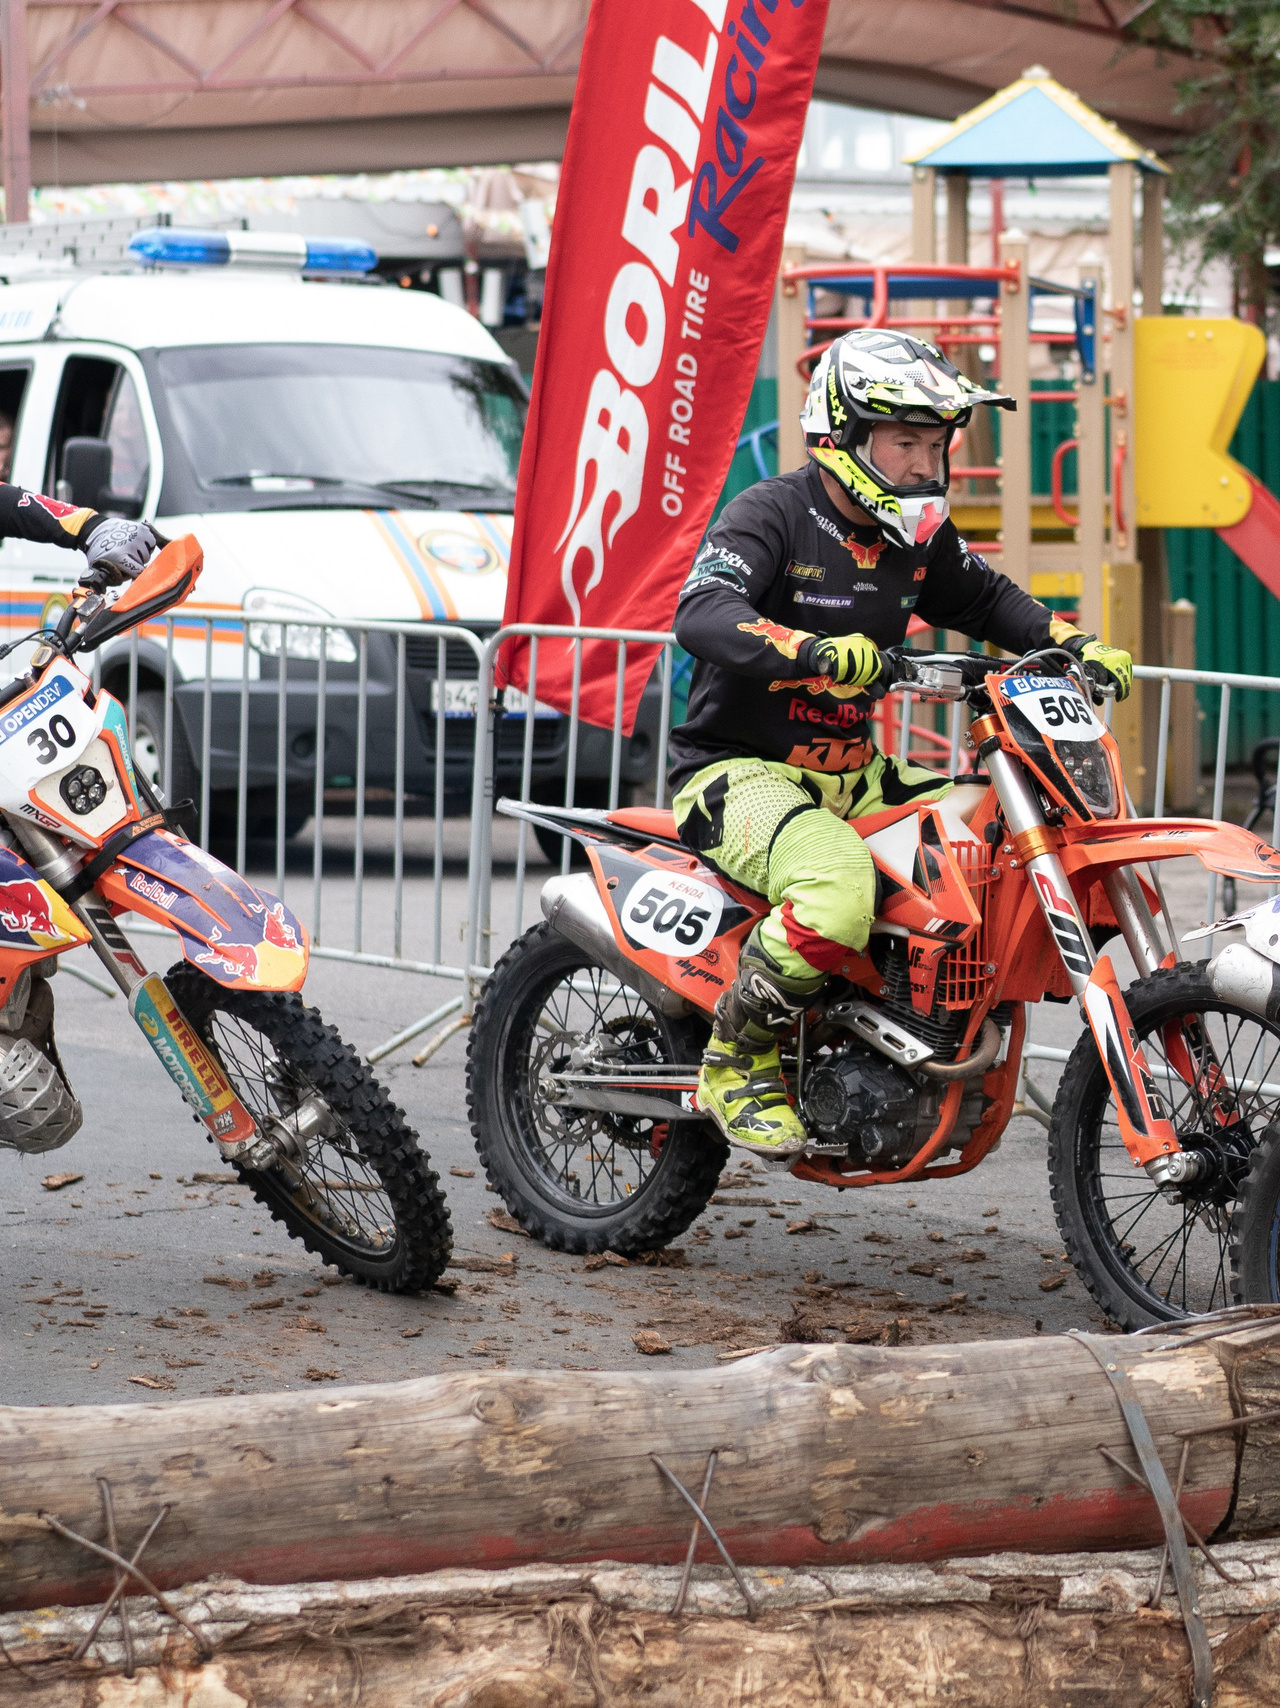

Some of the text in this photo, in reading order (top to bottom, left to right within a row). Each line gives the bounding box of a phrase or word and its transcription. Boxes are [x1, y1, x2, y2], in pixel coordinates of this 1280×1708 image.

[688, 0, 806, 254] Racin
[661, 268, 710, 517] OFF ROAD TIRE
[805, 596, 852, 607] MICHELIN
[4, 683, 62, 732] OPENDEV
[1038, 695, 1093, 727] 505
[27, 714, 76, 765] 30
[19, 803, 63, 829] MXGP
[668, 880, 705, 899] KENDA
[629, 887, 712, 946] 505
[153, 1036, 209, 1114] MOTOREX
